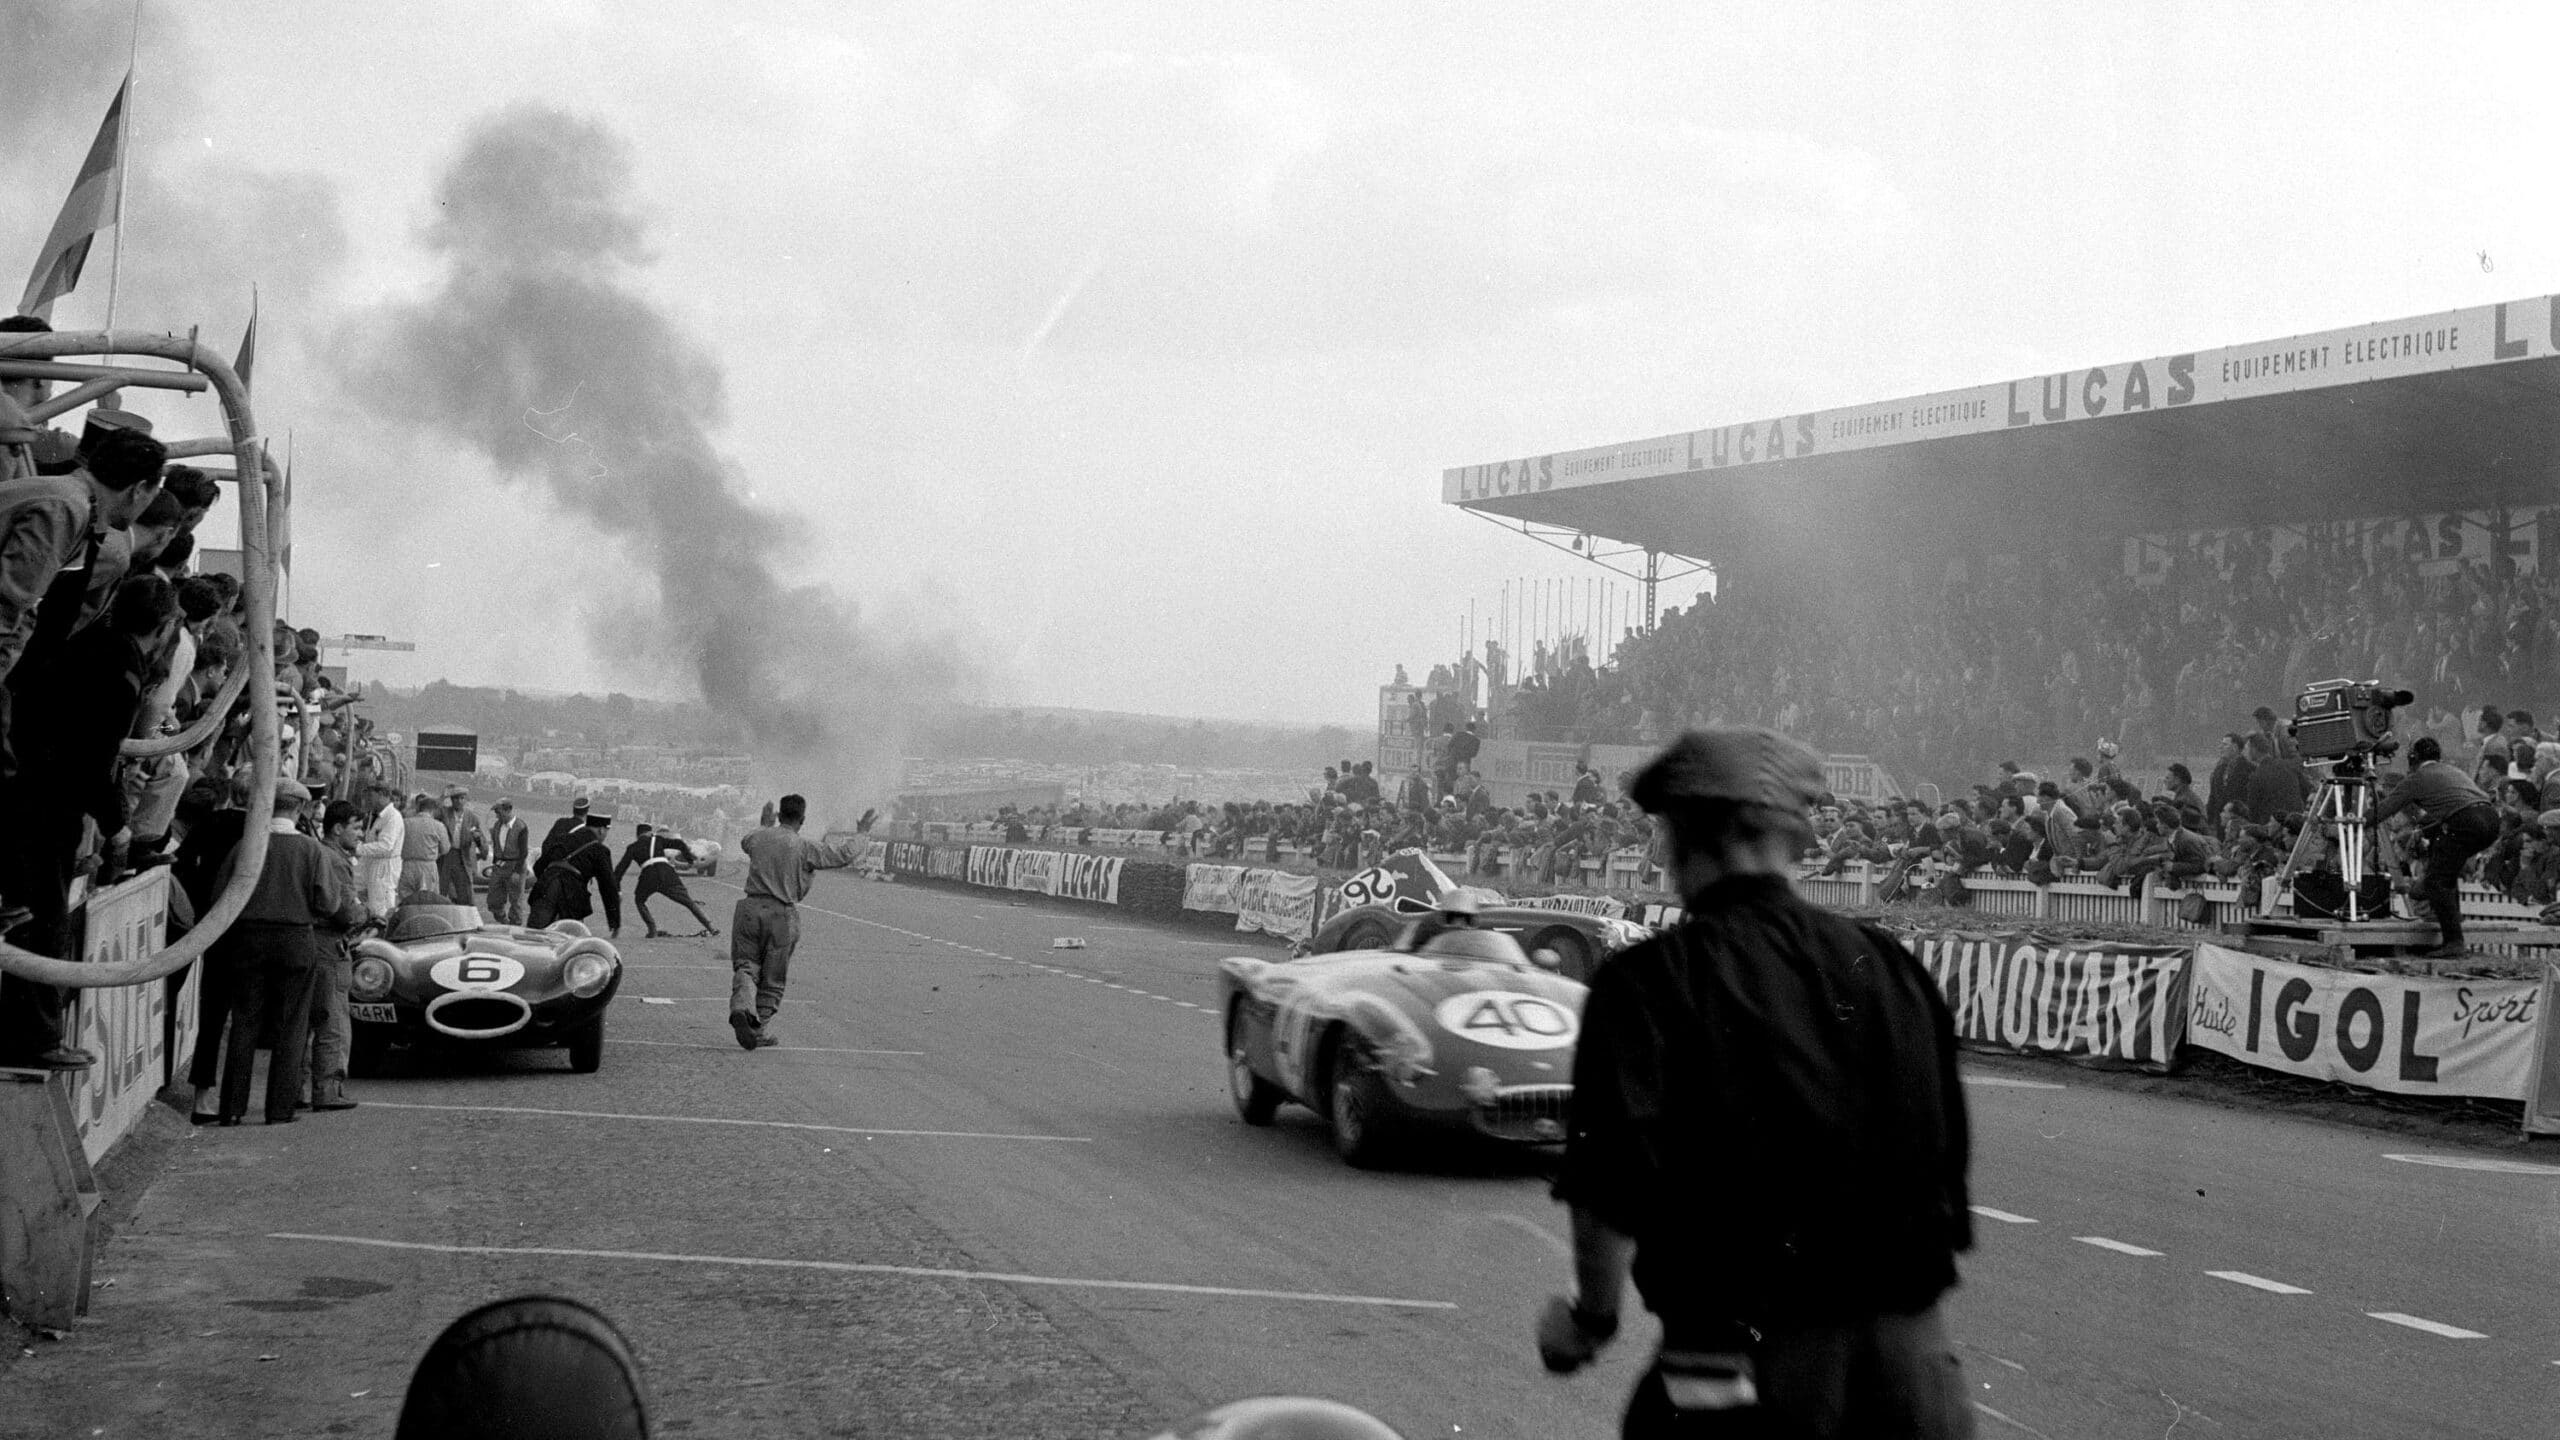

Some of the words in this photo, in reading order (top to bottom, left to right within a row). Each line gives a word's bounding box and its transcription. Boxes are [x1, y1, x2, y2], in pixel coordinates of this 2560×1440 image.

[1460, 455, 1552, 500] LUCAS
[1686, 412, 1816, 471] LUCAS
[2007, 353, 2196, 428] LUCAS
[2222, 346, 2331, 384] ÉQUIPEMENT
[2344, 325, 2459, 366] ÉLECTRIQUE
[970, 846, 1013, 887] LUCAS
[1061, 853, 1116, 901] LUCAS
[457, 955, 502, 983] 6
[1464, 999, 1570, 1037] 40
[2191, 984, 2237, 1037] Huile
[2245, 967, 2440, 1084] IGOL
[2453, 986, 2540, 1040] Sport
